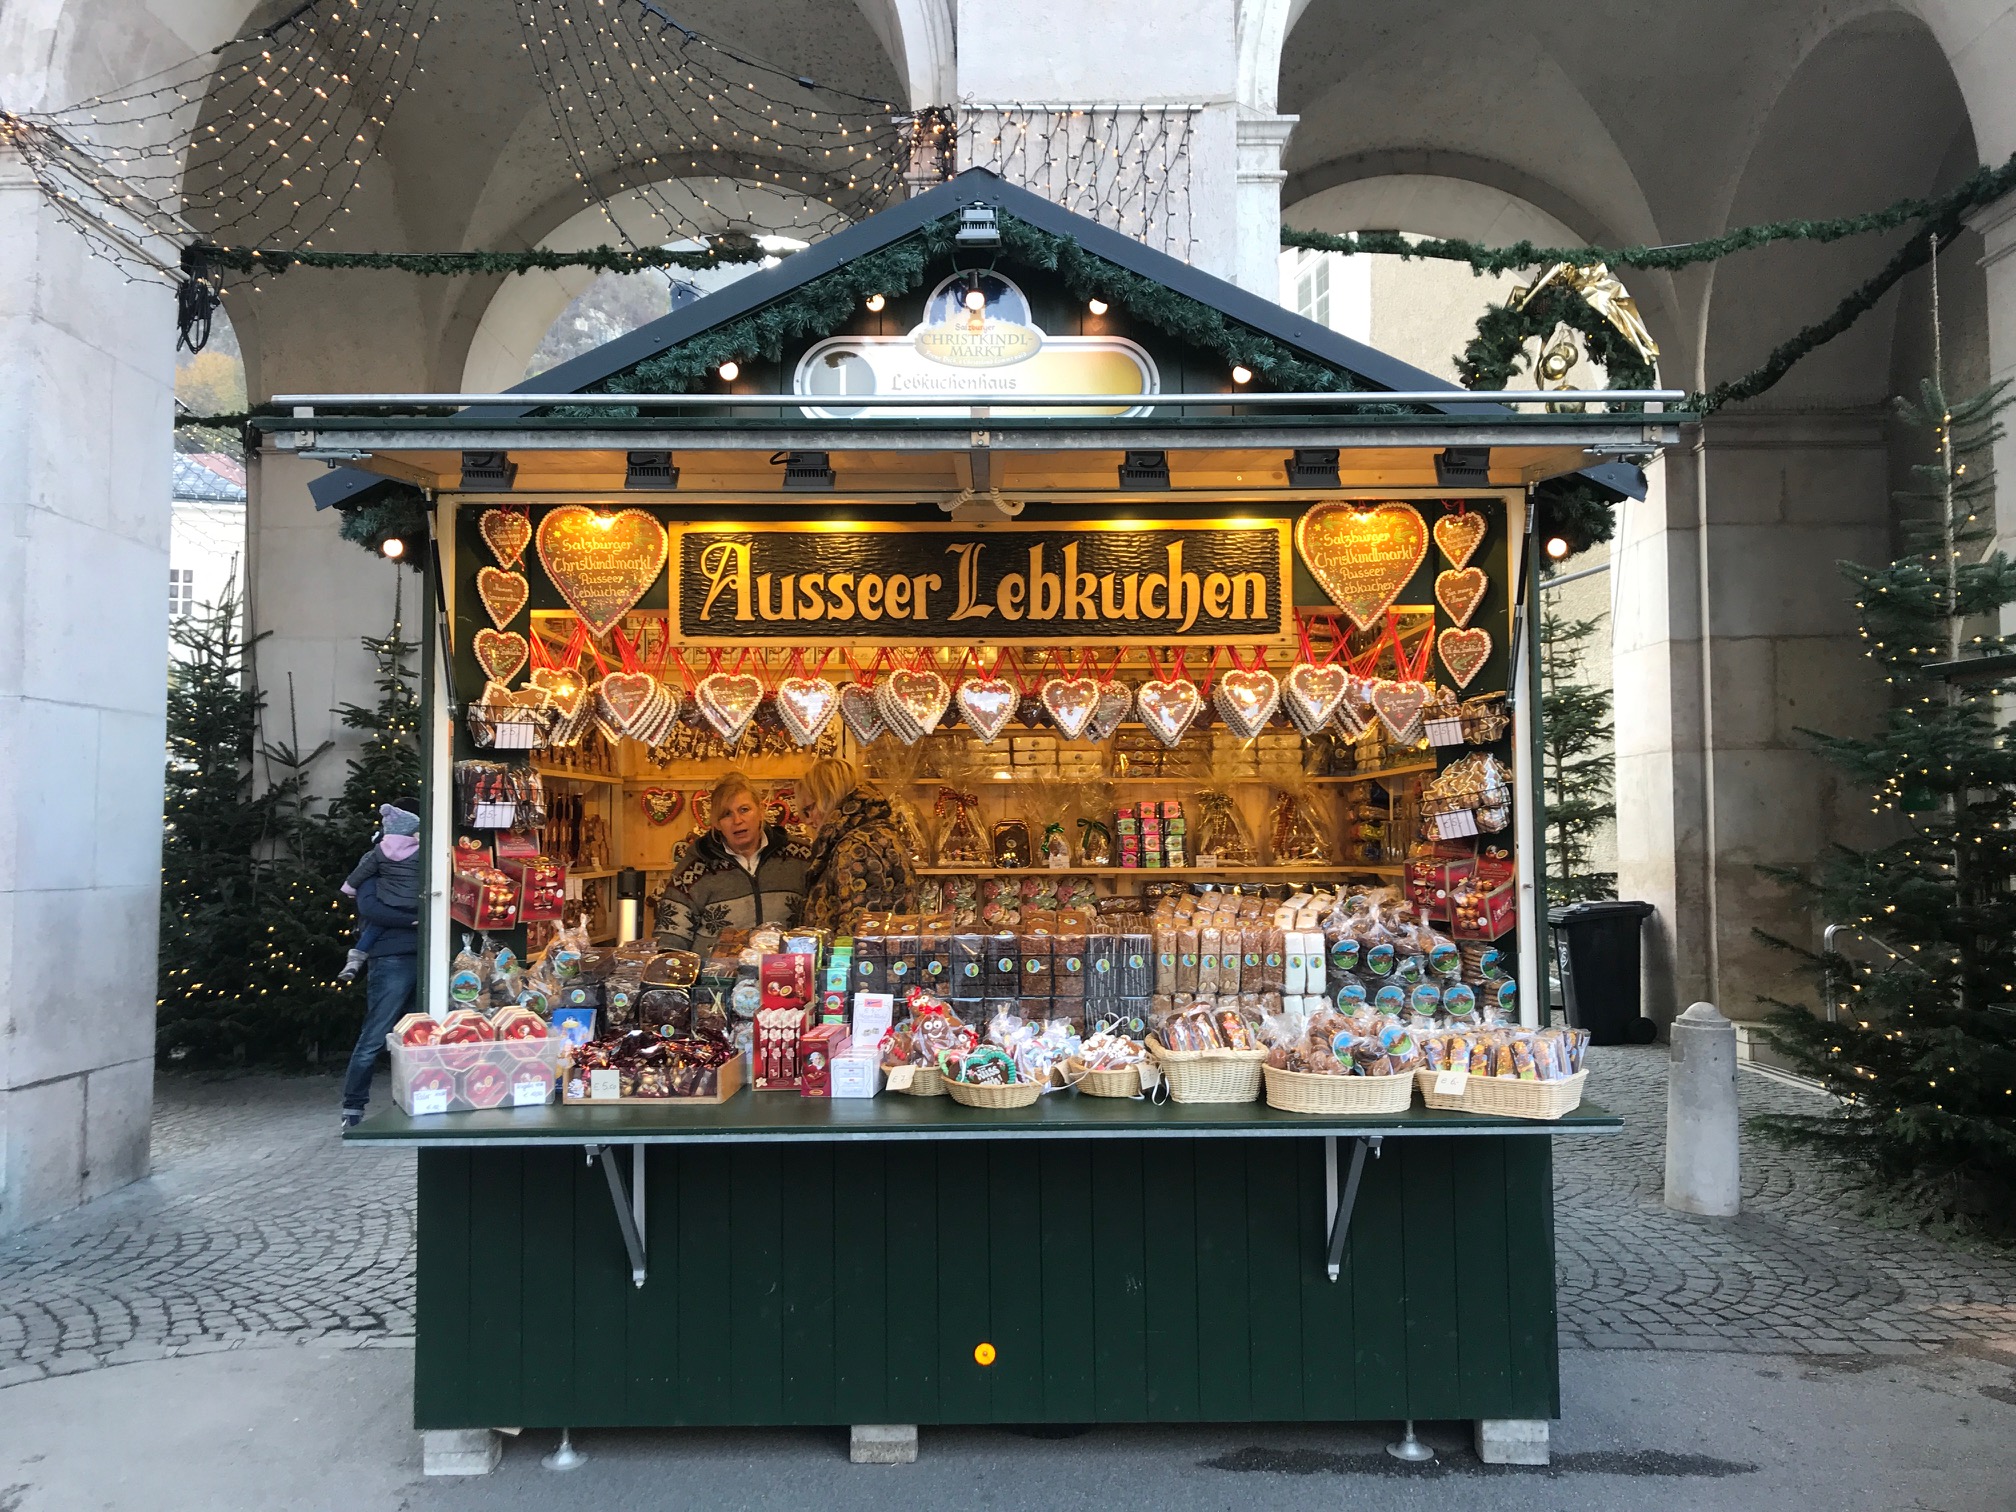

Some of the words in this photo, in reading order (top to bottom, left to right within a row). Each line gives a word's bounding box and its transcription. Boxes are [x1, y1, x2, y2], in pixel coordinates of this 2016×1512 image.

[920, 333, 1033, 345] CHRISTKINDL-
[950, 346, 1005, 357] MARKT
[831, 364, 847, 396] 1
[891, 373, 1017, 391] Lebkuchenhaus
[562, 538, 633, 553] Salzburger
[1323, 531, 1390, 548] Salzburger
[552, 554, 652, 573] Christkindlmarkt
[1314, 547, 1415, 569] Christkindlmarkt
[578, 572, 624, 585] Ausseer
[1340, 566, 1387, 581] Ausseer
[572, 585, 631, 599] Lebkuchen
[699, 541, 942, 621] Ausseer
[946, 540, 1269, 632] Lebkuchen
[1337, 580, 1395, 596] Lebkuchen
